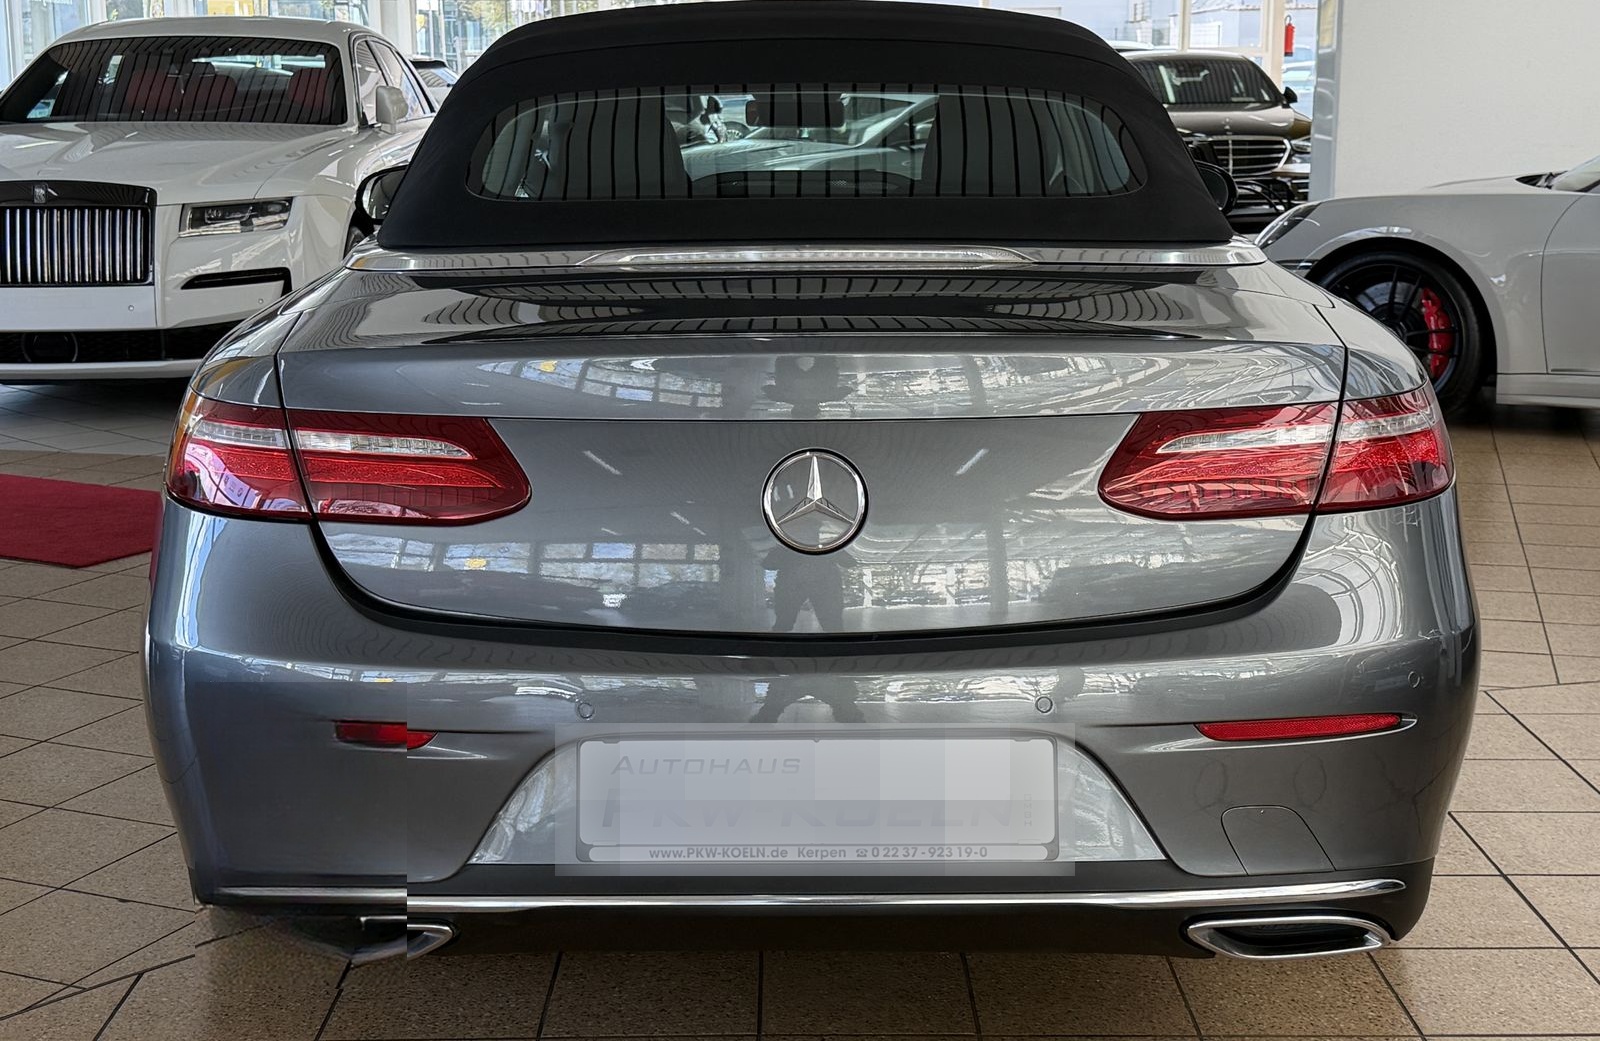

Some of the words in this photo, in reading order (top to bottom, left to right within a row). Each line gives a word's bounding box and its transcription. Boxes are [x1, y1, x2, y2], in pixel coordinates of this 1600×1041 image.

[610, 755, 801, 776] AUTOHAUS
[649, 847, 789, 859] www.PKW-KOELN.de
[797, 847, 847, 860] Kerpen
